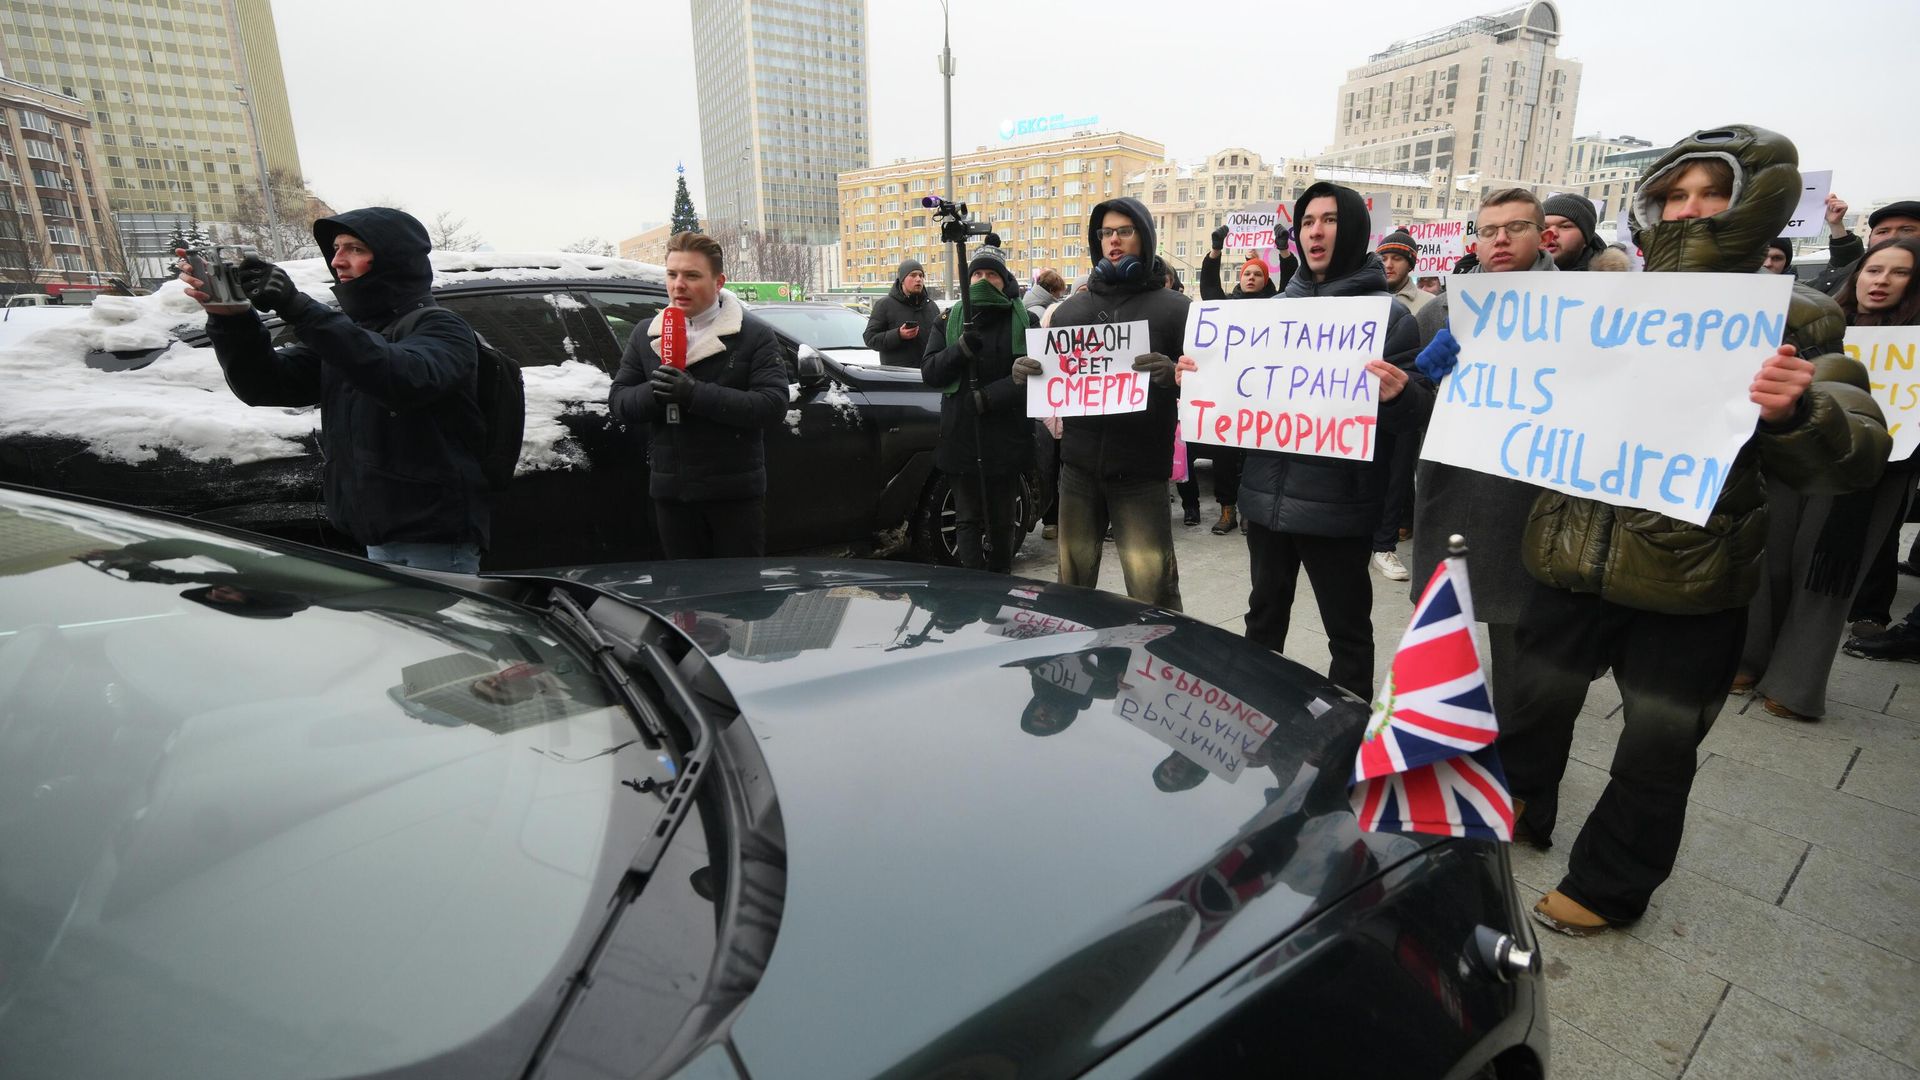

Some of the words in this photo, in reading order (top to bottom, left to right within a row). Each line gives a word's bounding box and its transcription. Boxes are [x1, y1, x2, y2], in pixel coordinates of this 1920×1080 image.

[1017, 117, 1047, 135] БКС
[1228, 214, 1275, 226] ЛОНДОН
[1225, 231, 1275, 247] СМЕРТЬ
[663, 318, 673, 365] ЗВЕЗДА
[1045, 324, 1131, 355] ЛОНДОН
[1065, 357, 1113, 375] СЕЕТ
[1047, 372, 1145, 408] СМЕРТЬ
[1236, 365, 1371, 402] СТРАНА
[1446, 363, 1557, 415] KILLS
